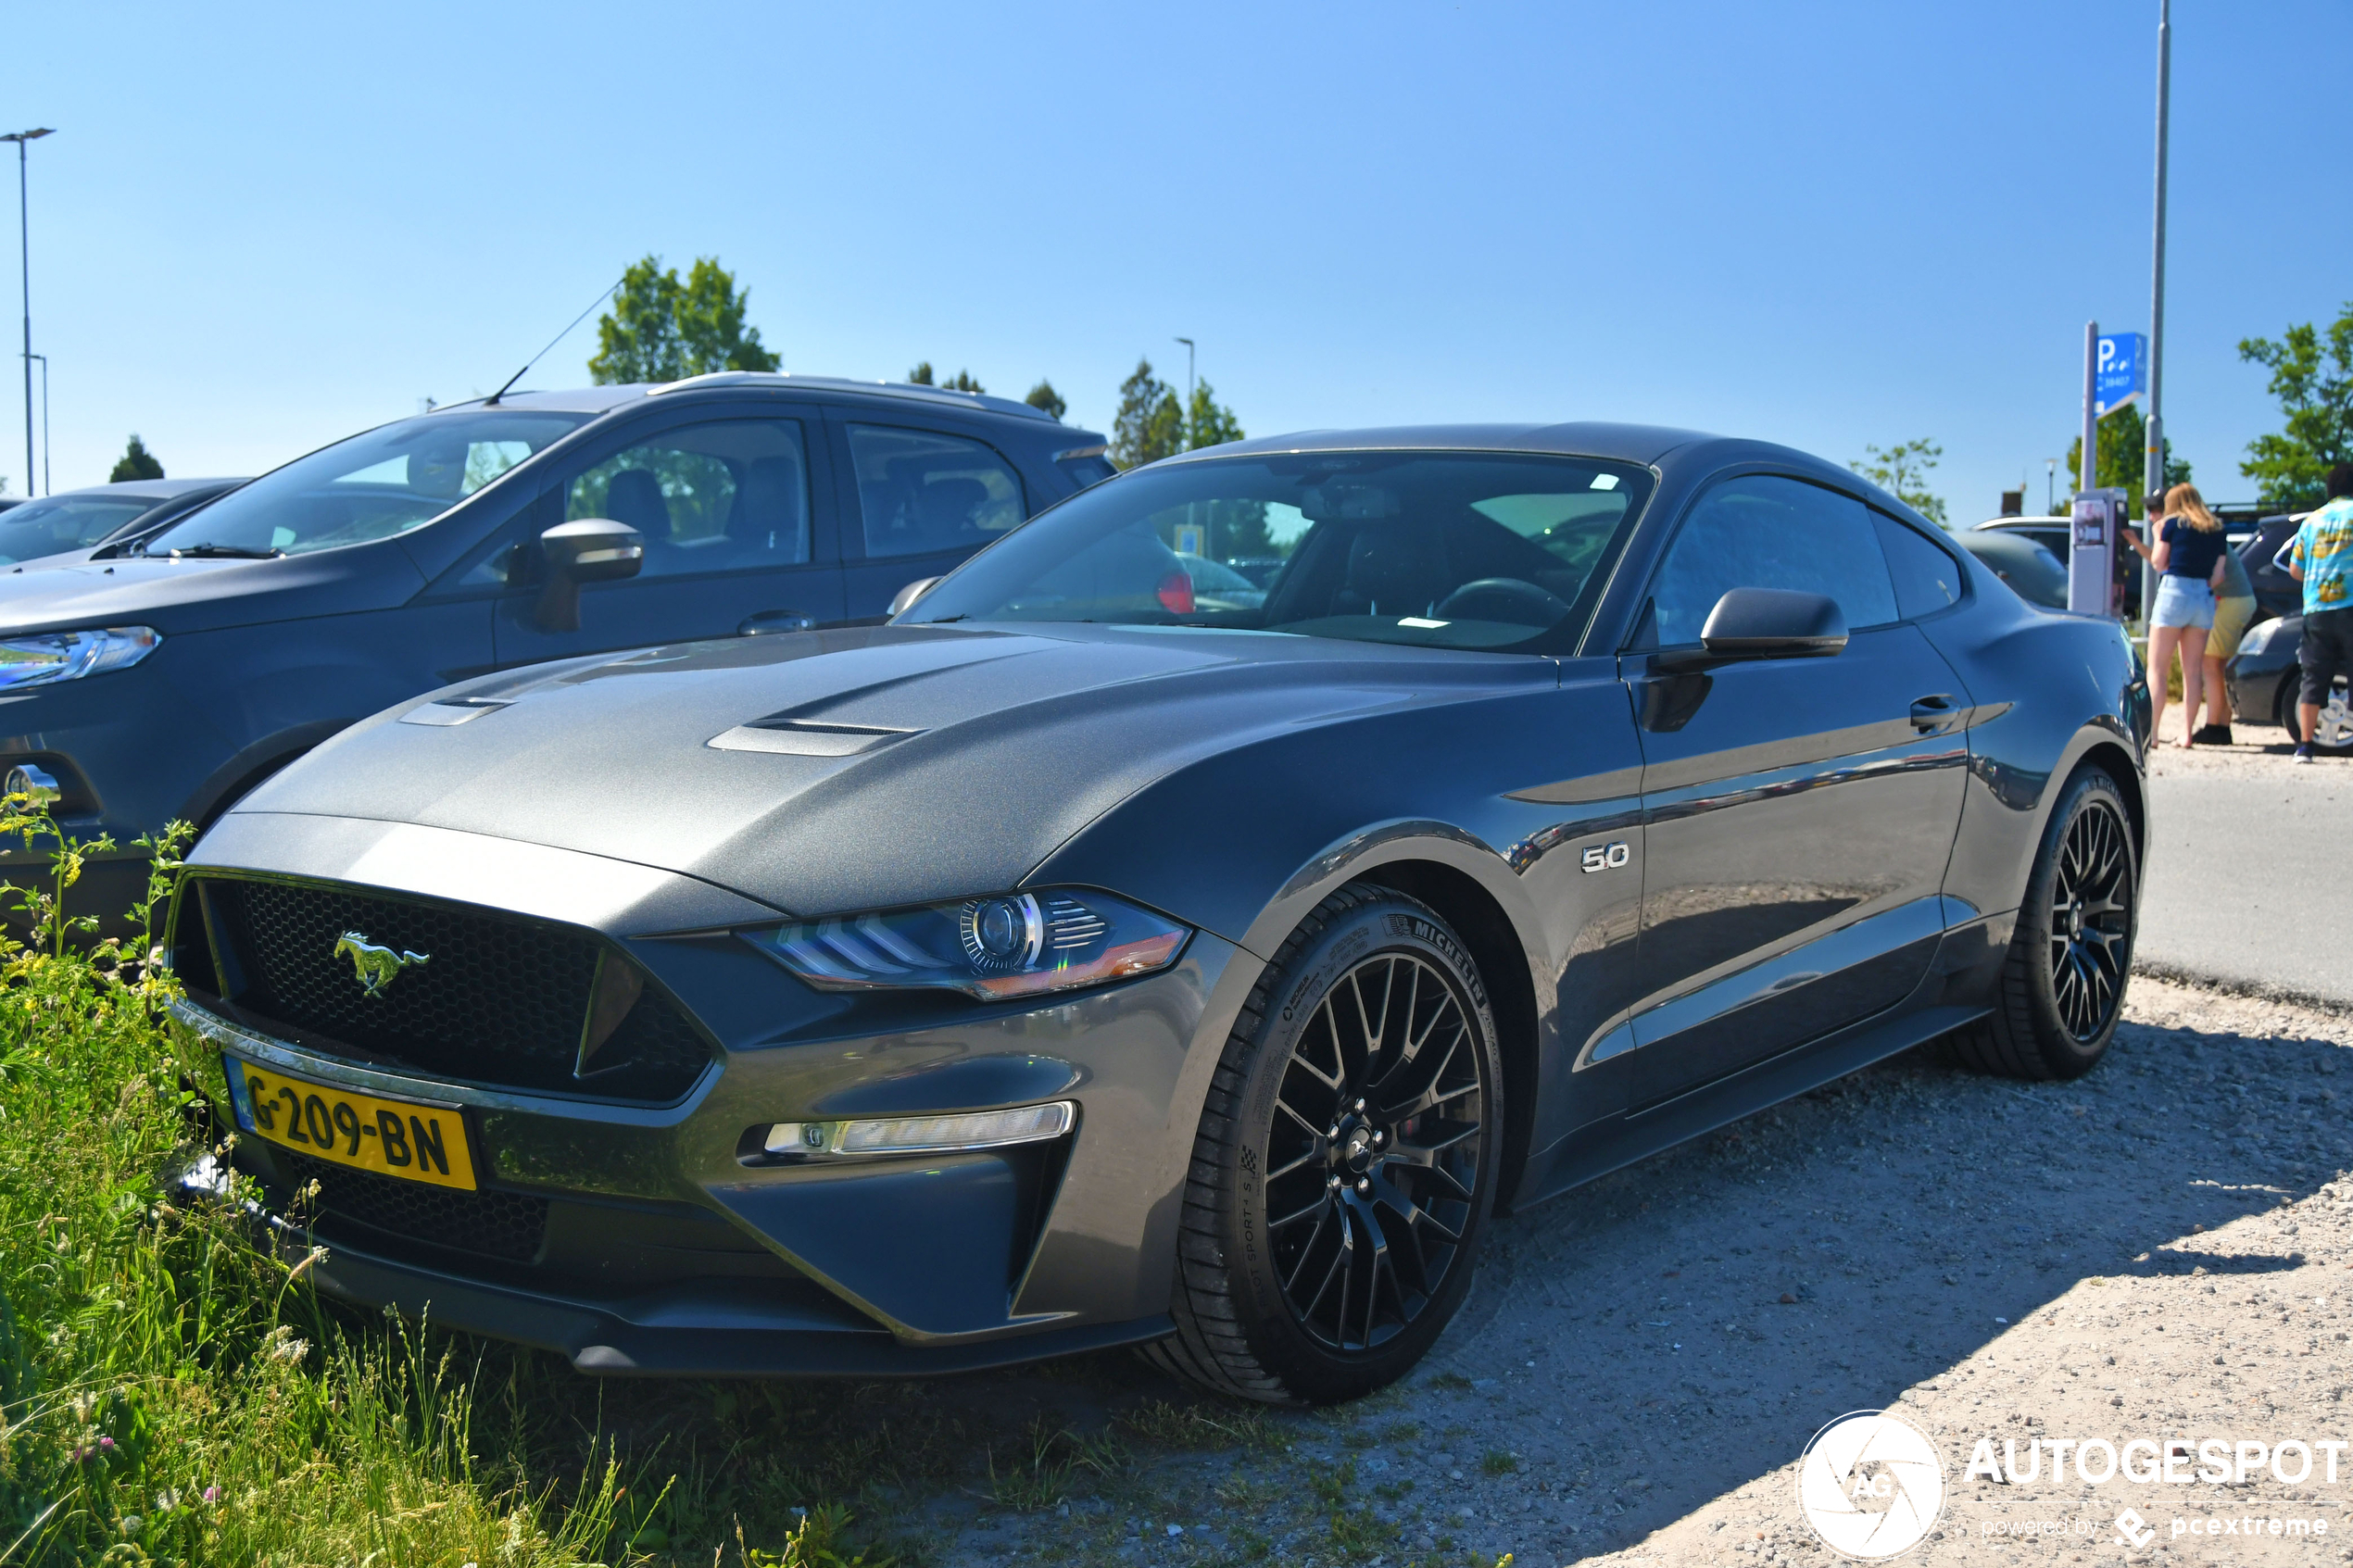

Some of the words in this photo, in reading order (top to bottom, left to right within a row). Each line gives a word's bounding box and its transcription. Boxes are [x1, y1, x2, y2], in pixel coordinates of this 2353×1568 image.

[2097, 339, 2115, 373] P
[1415, 921, 1483, 1001] MICHELIN
[1290, 974, 1309, 1007] MICHELIN
[247, 1075, 450, 1176] G-209-BN
[1243, 1182, 1252, 1192] S
[1243, 1208, 1256, 1261] SPORT
